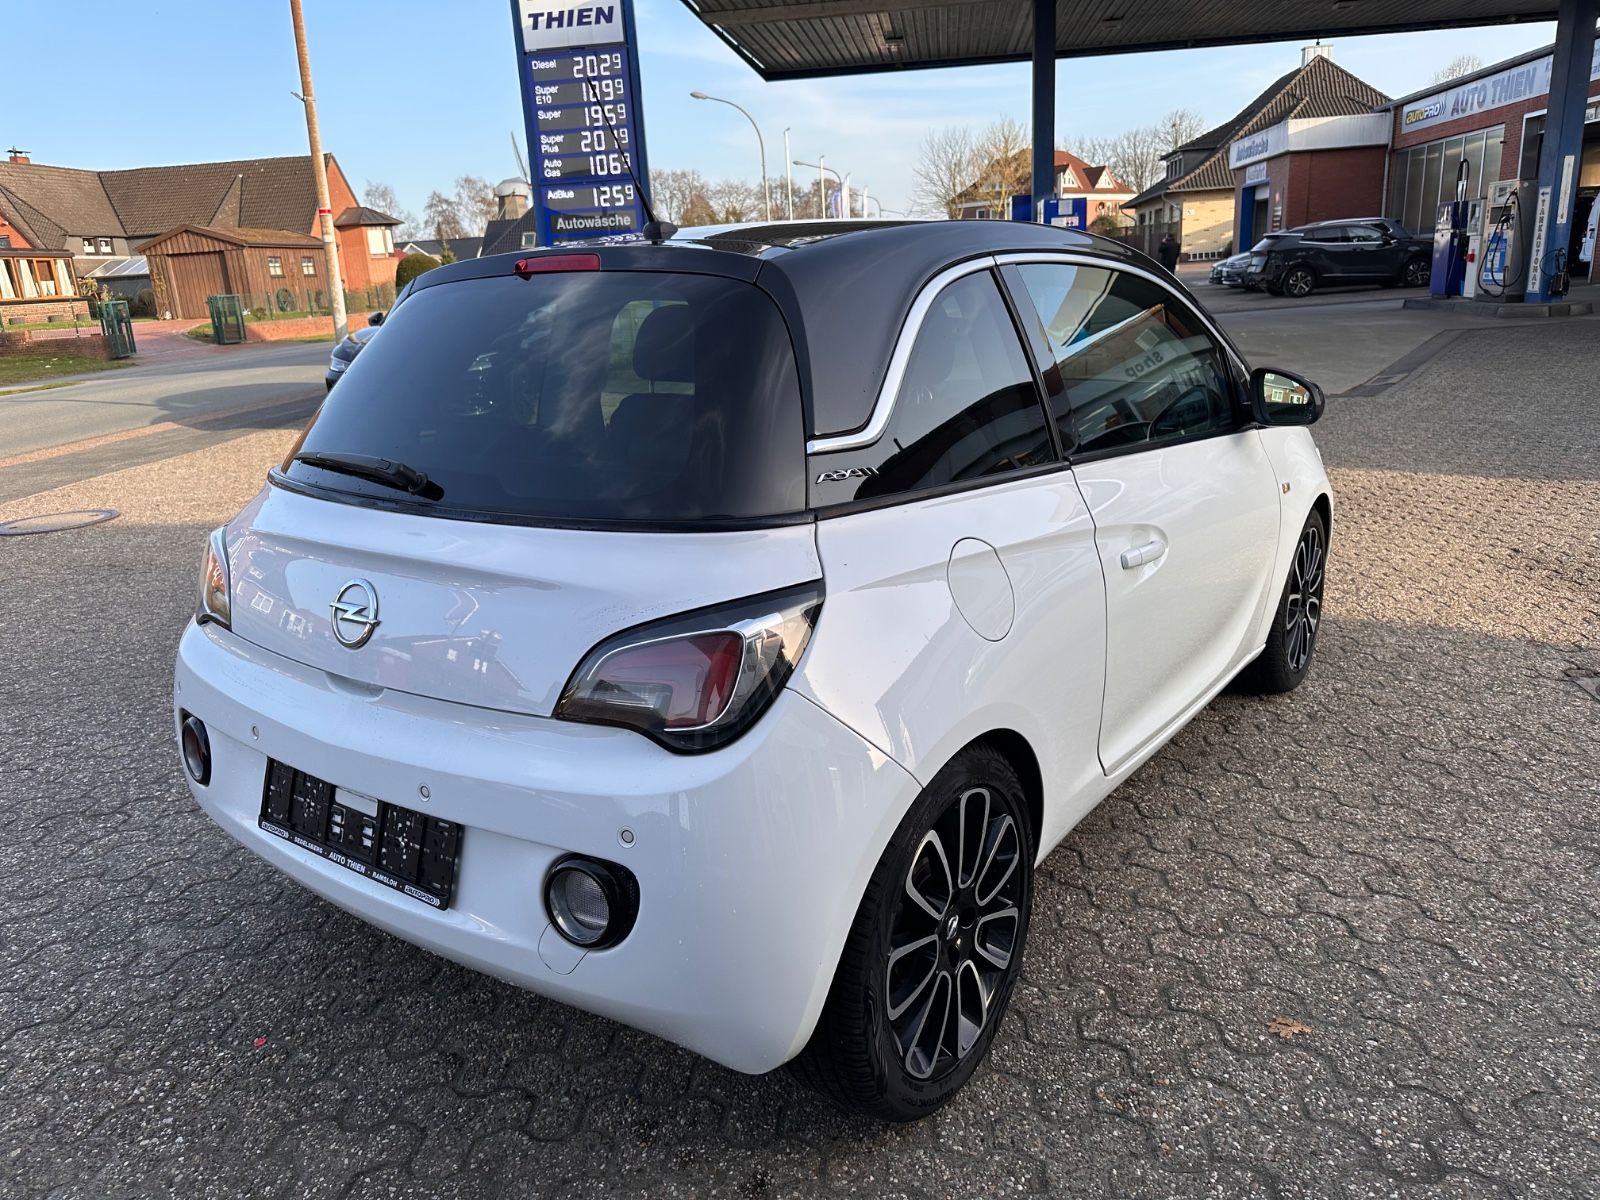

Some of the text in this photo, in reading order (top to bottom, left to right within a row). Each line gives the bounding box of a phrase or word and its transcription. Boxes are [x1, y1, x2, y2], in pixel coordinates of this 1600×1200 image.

[528, 6, 614, 30] THIEN
[532, 60, 556, 70] Diesel
[535, 85, 559, 95] Super
[1451, 83, 1487, 117] AUTO
[1491, 67, 1537, 104] THIEN
[536, 96, 552, 105] E10
[538, 110, 561, 120] Super
[540, 135, 564, 144] Super
[541, 145, 559, 153] Plus
[544, 159, 562, 168] Auto
[544, 169, 561, 177] Gas
[548, 190, 574, 199] AdBlue
[557, 214, 631, 230] Autowäsche
[328, 851, 346, 864] AUTO
[346, 859, 366, 874] THIEN
